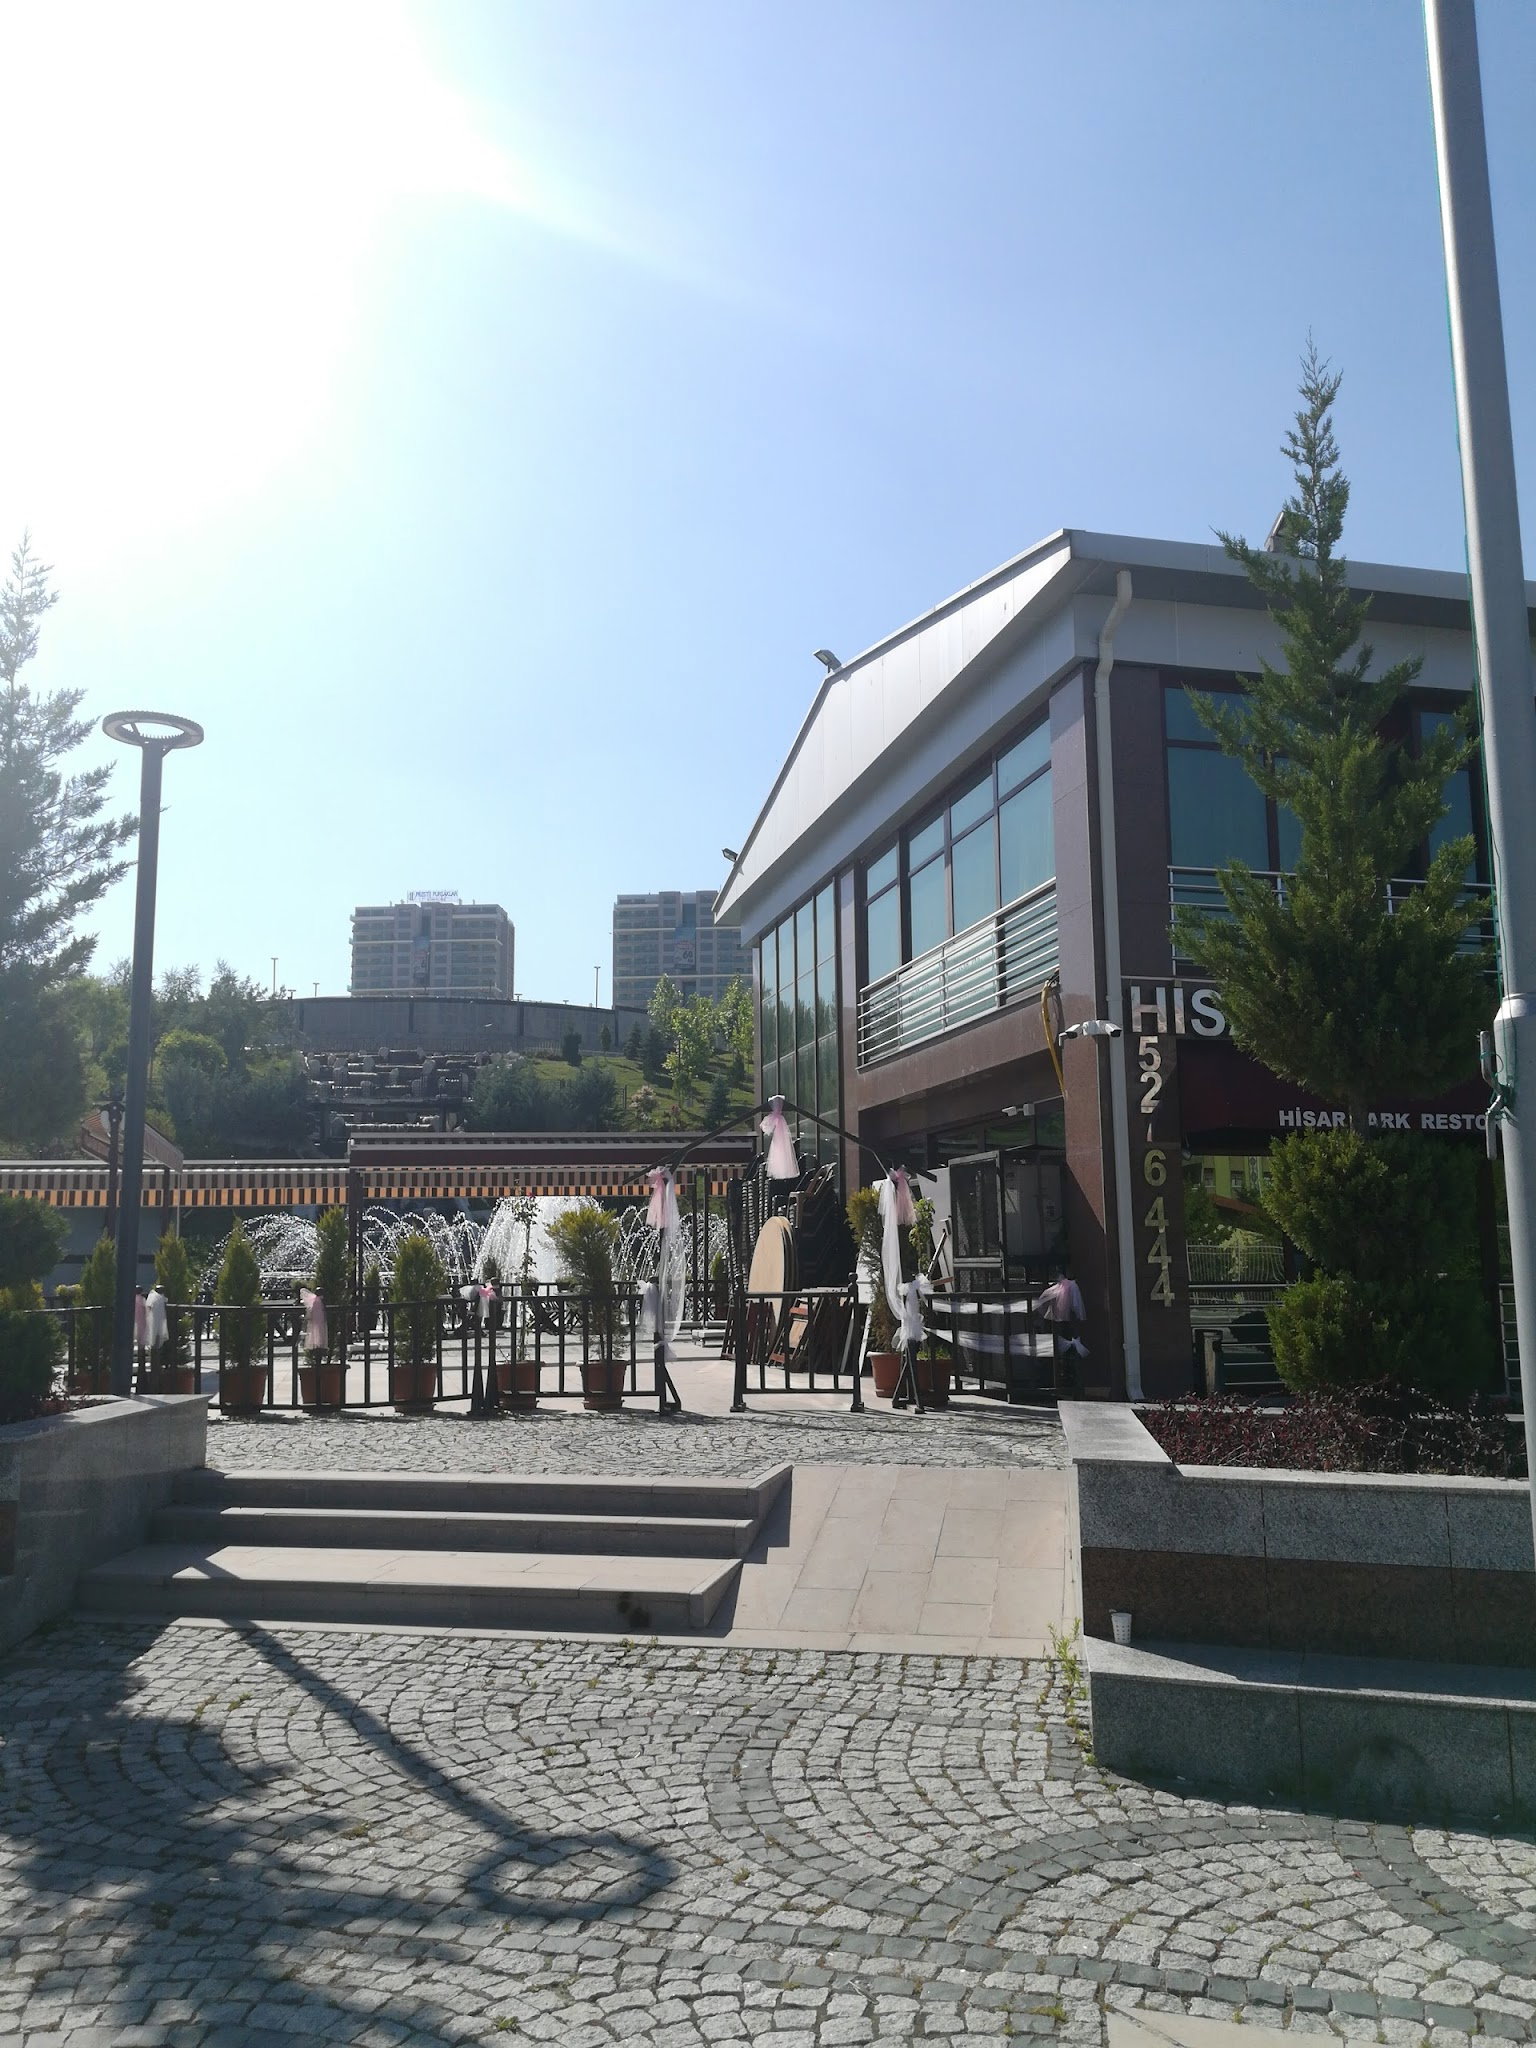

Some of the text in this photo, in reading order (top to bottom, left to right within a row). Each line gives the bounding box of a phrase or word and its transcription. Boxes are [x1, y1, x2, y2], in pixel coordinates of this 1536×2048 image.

[1279, 1107, 1501, 1130] HİSAR ARK RESTO
